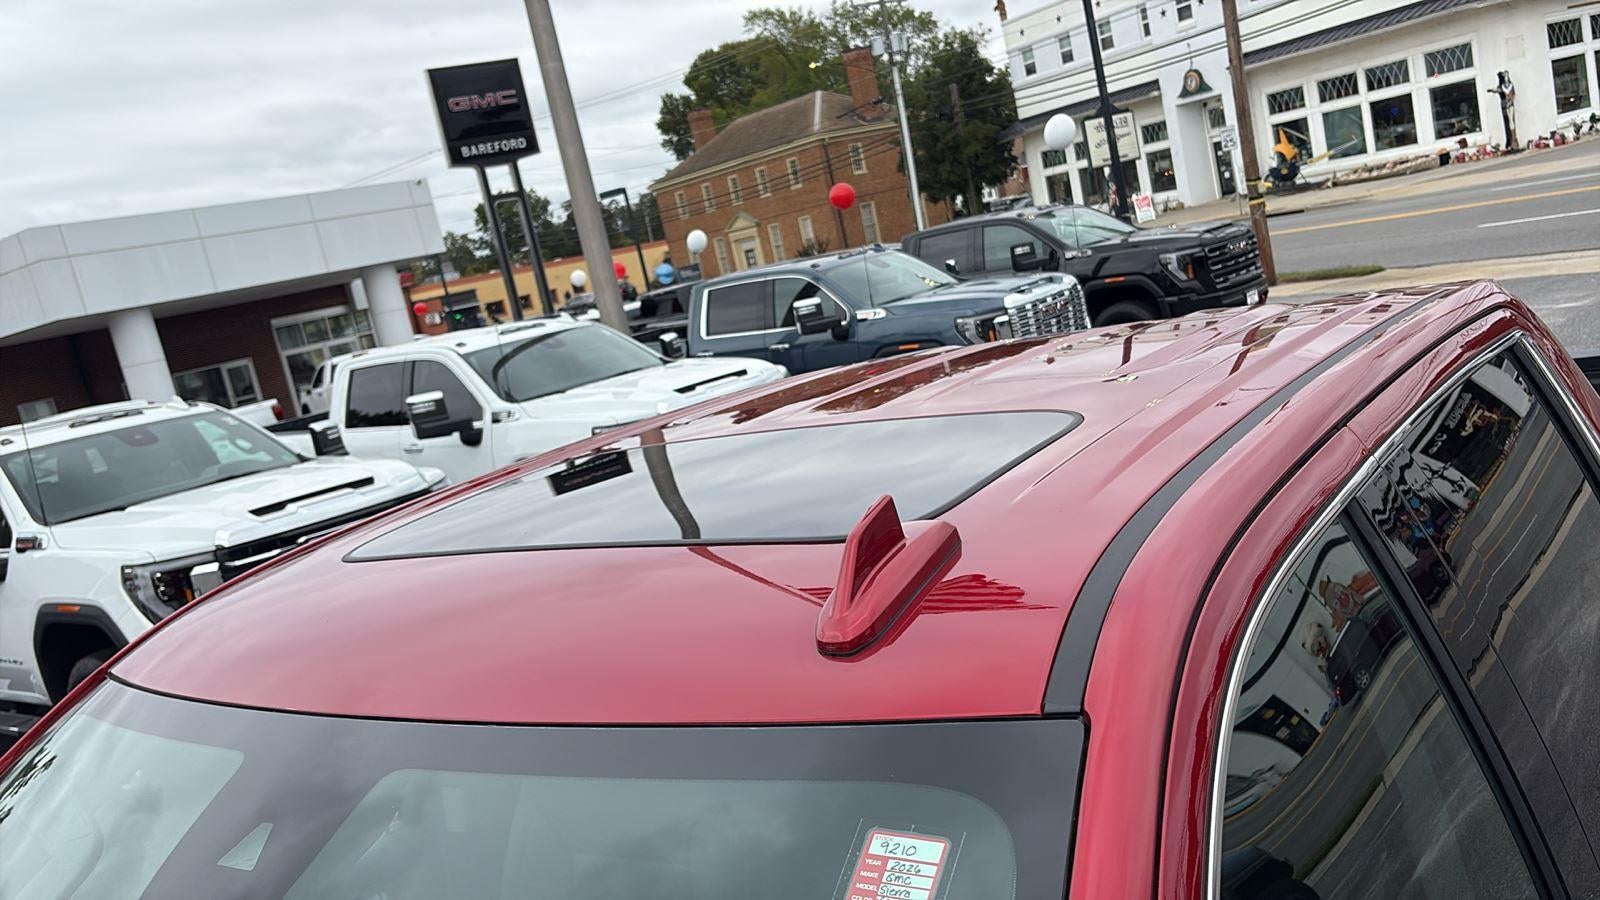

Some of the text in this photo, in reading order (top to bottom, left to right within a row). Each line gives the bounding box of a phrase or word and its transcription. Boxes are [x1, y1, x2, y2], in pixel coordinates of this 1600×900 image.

[447, 89, 519, 113] GMC
[460, 137, 528, 158] BAREFORD
[880, 841, 917, 856] 9210
[865, 858, 882, 866] YEAR
[890, 861, 922, 874] 2026
[859, 870, 879, 878] MAKE
[855, 882, 878, 892] MODEL
[879, 885, 911, 898] Sierra
